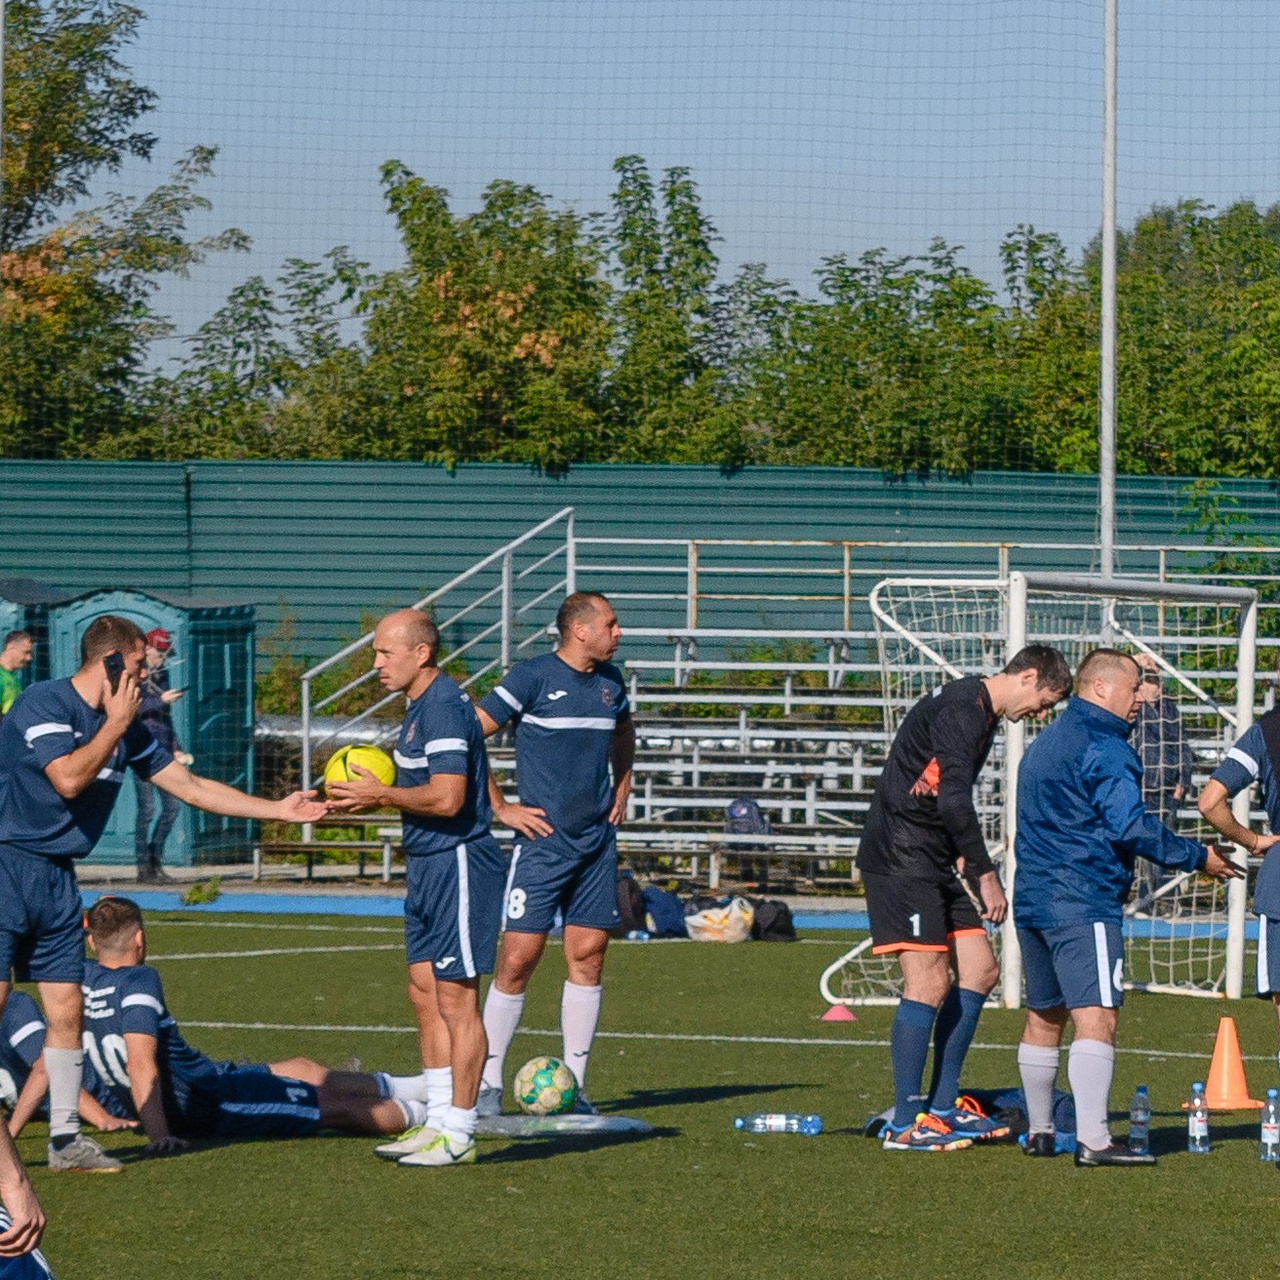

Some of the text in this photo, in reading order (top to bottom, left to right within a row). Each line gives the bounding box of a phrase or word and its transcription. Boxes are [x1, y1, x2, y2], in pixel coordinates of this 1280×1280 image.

[507, 887, 527, 919] 8
[909, 913, 920, 937] 1
[82, 1030, 132, 1088] 10
